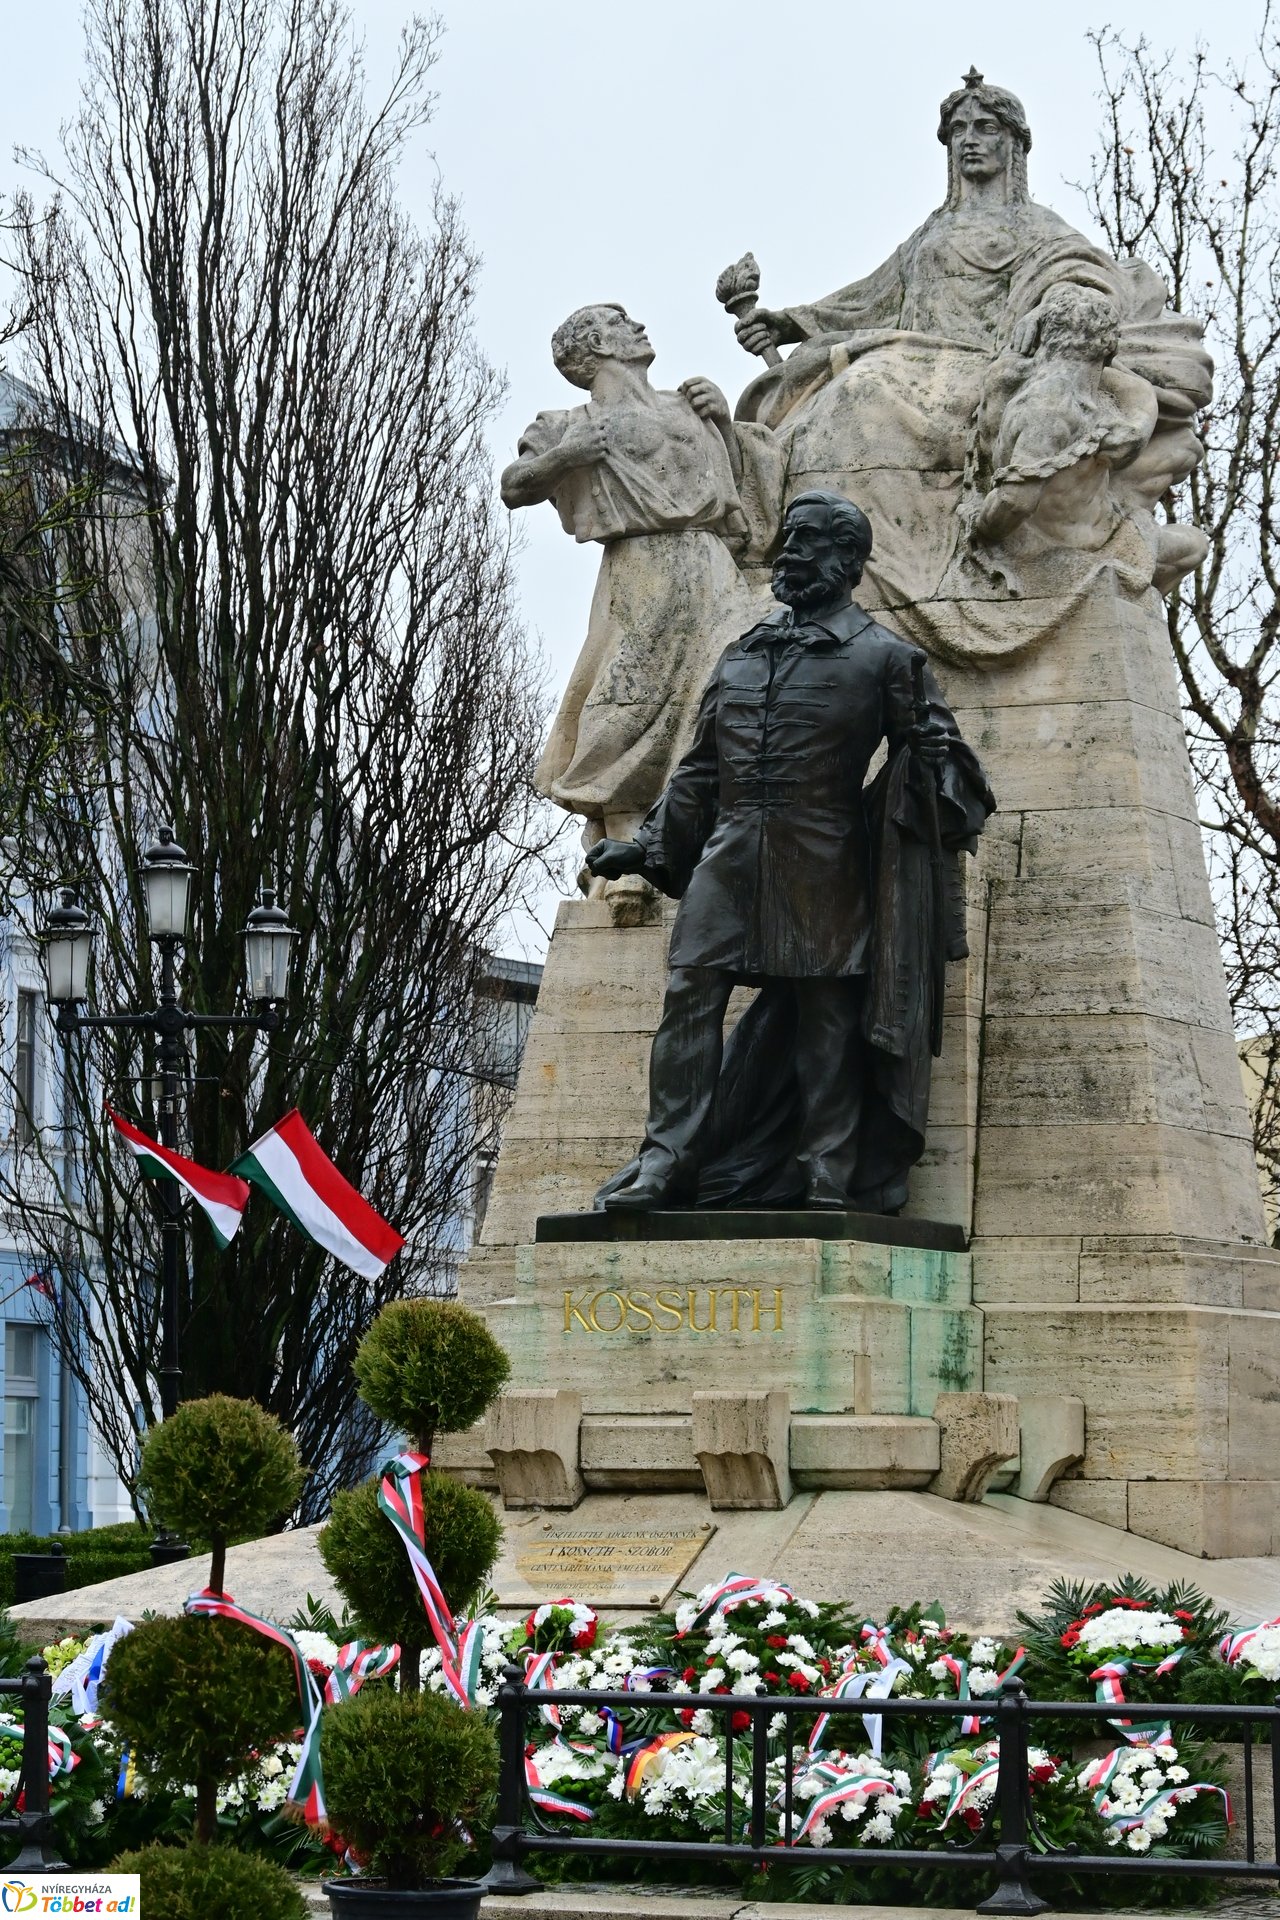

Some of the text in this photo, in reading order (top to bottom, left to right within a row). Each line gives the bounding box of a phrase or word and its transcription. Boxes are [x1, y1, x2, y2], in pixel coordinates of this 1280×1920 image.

[562, 1289, 785, 1334] KOSSUTH
[557, 1546, 616, 1557] KOSSUTH
[625, 1546, 673, 1557] SZOBOR
